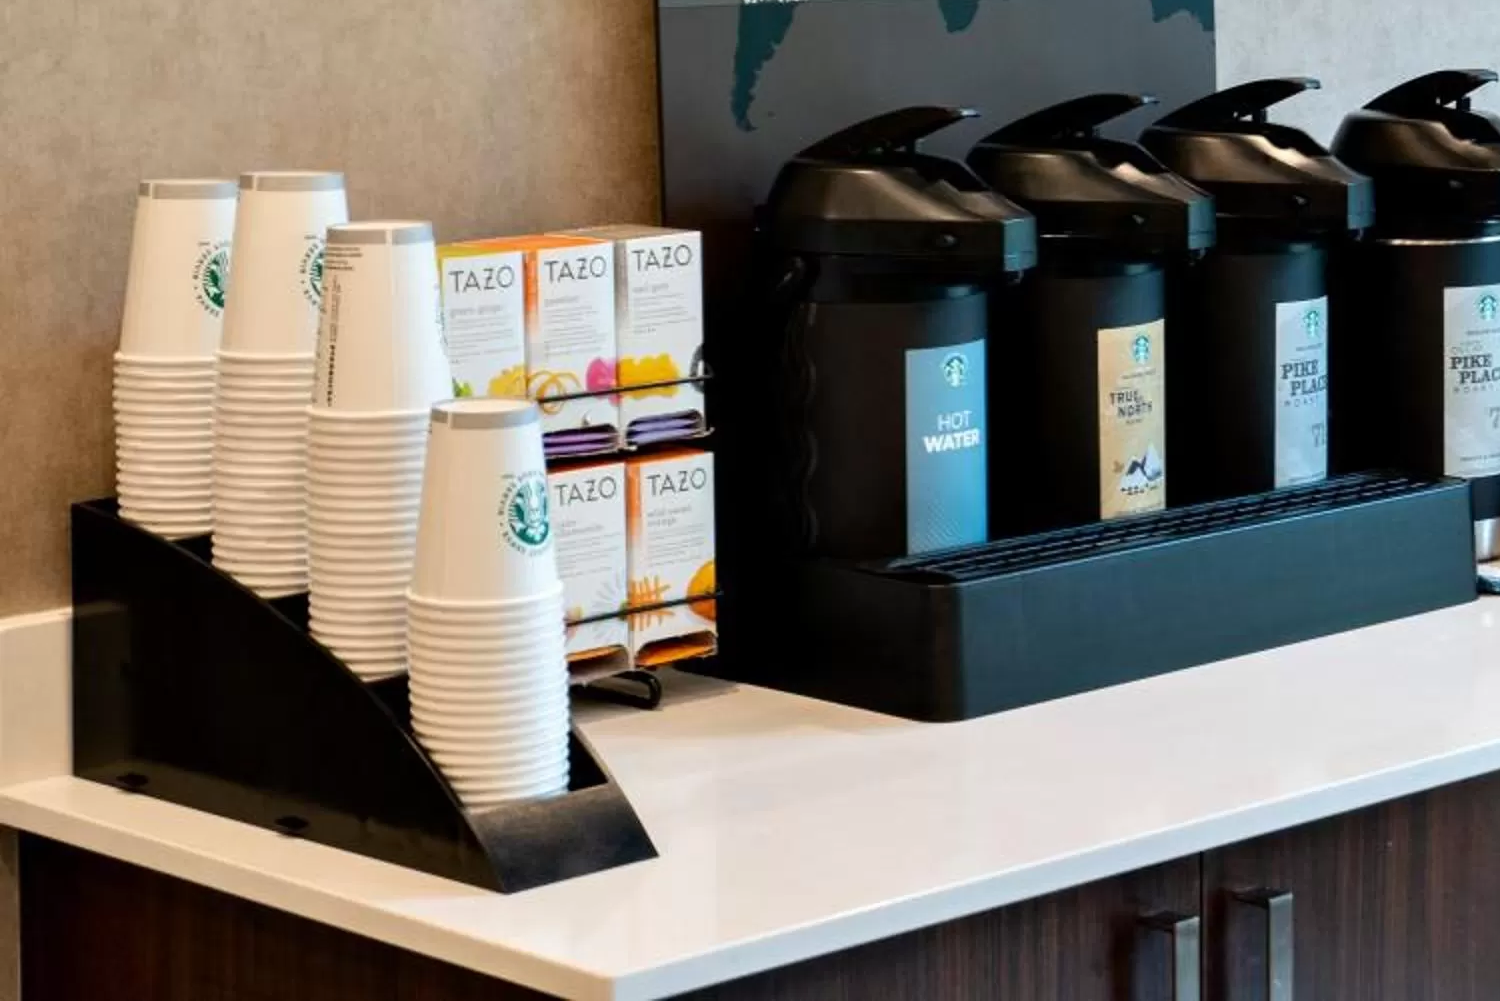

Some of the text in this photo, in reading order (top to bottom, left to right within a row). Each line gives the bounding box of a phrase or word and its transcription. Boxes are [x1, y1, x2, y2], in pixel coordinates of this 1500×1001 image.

[543, 255, 608, 284] TAZO
[631, 244, 693, 271] TAZO
[447, 265, 516, 294] TAZO
[1280, 358, 1319, 380] PIKE
[1449, 353, 1492, 370] PIKE
[937, 410, 973, 432] HOT
[923, 428, 980, 453] WATER
[554, 475, 617, 506] TAZO
[646, 467, 707, 496] TAZO
